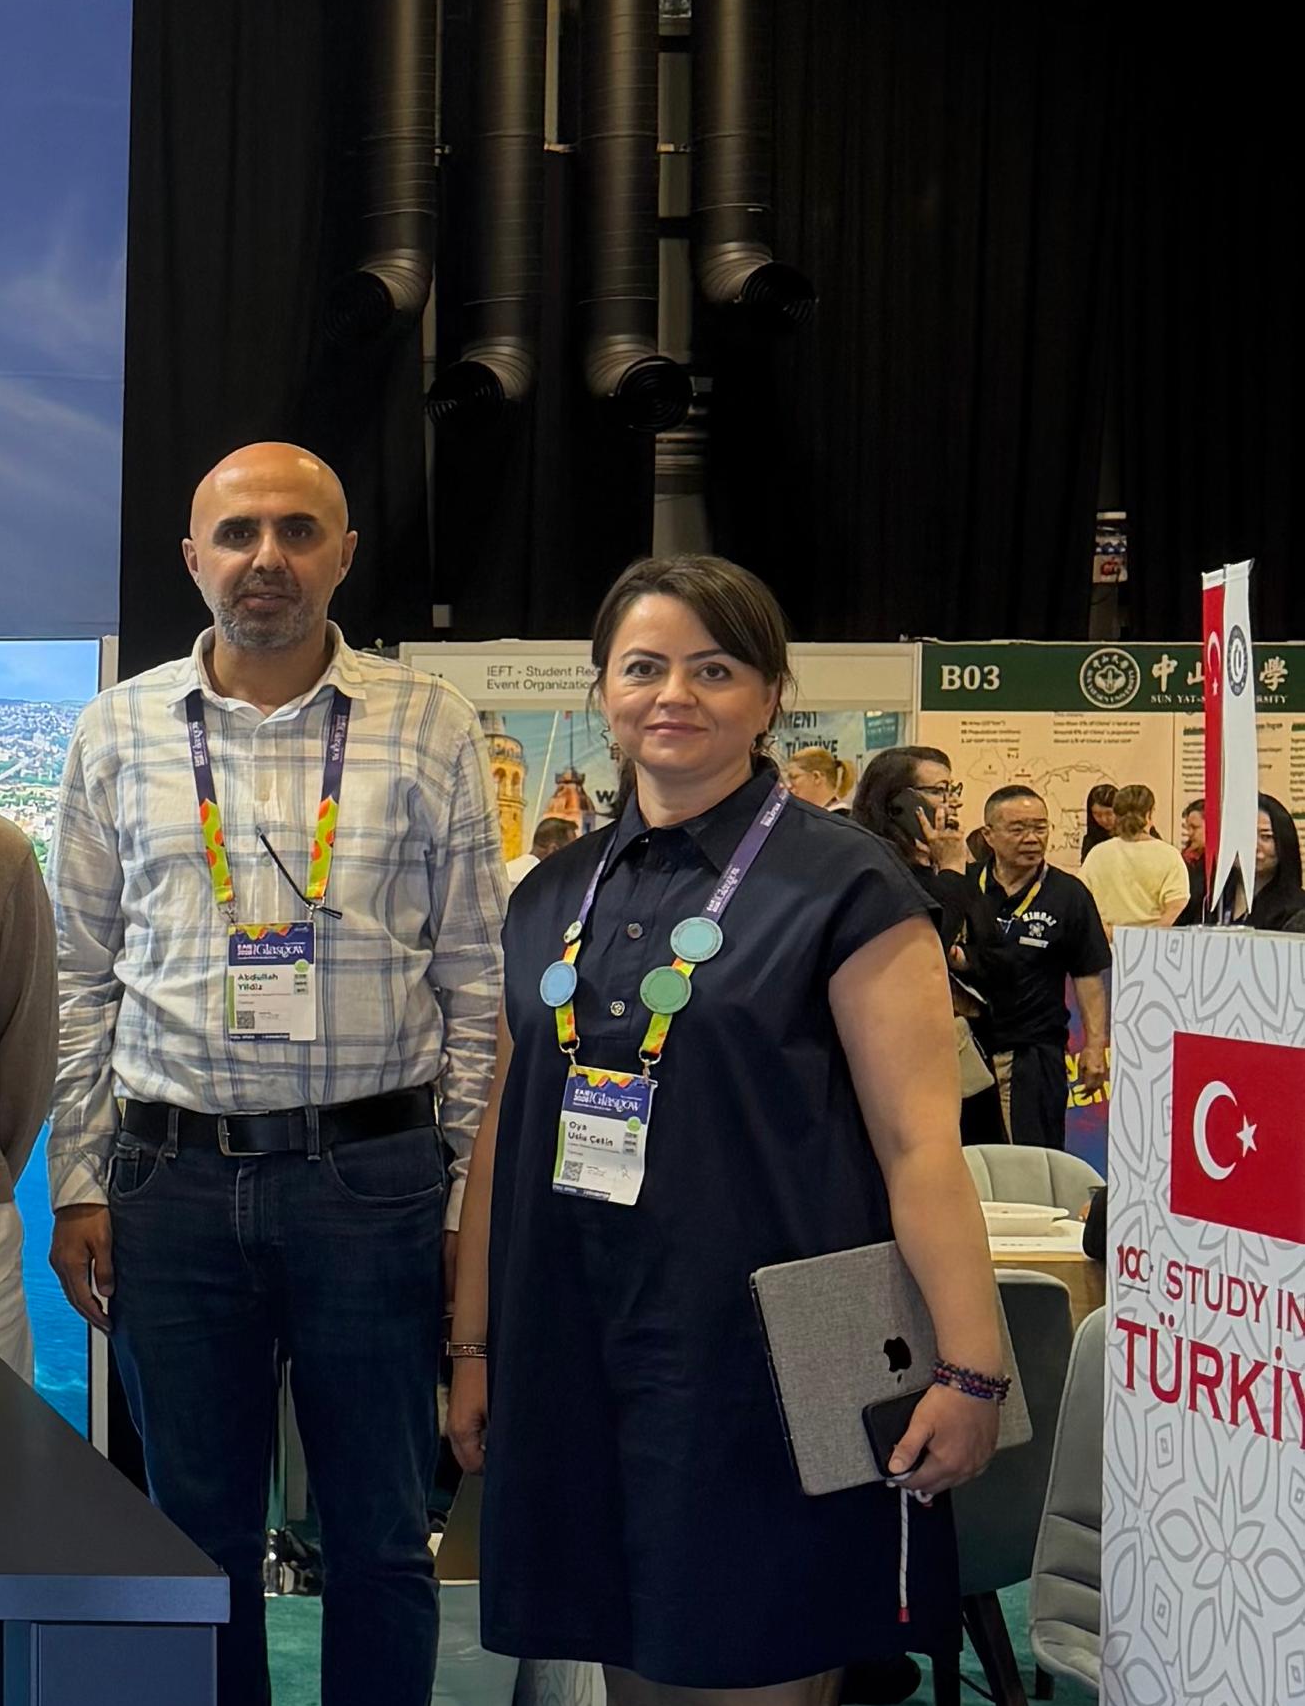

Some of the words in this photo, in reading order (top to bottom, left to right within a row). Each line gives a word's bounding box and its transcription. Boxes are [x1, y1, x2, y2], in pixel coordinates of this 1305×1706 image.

[487, 666, 514, 677] IEFT
[526, 665, 572, 677] Student
[941, 664, 1000, 691] B03
[487, 679, 519, 690] Event
[523, 679, 594, 692] Organizatio
[1151, 695, 1172, 704] SUN
[1166, 1260, 1268, 1324] STUDY
[1277, 1288, 1305, 1336] IN
[1116, 1311, 1305, 1451] TÜRKİ
